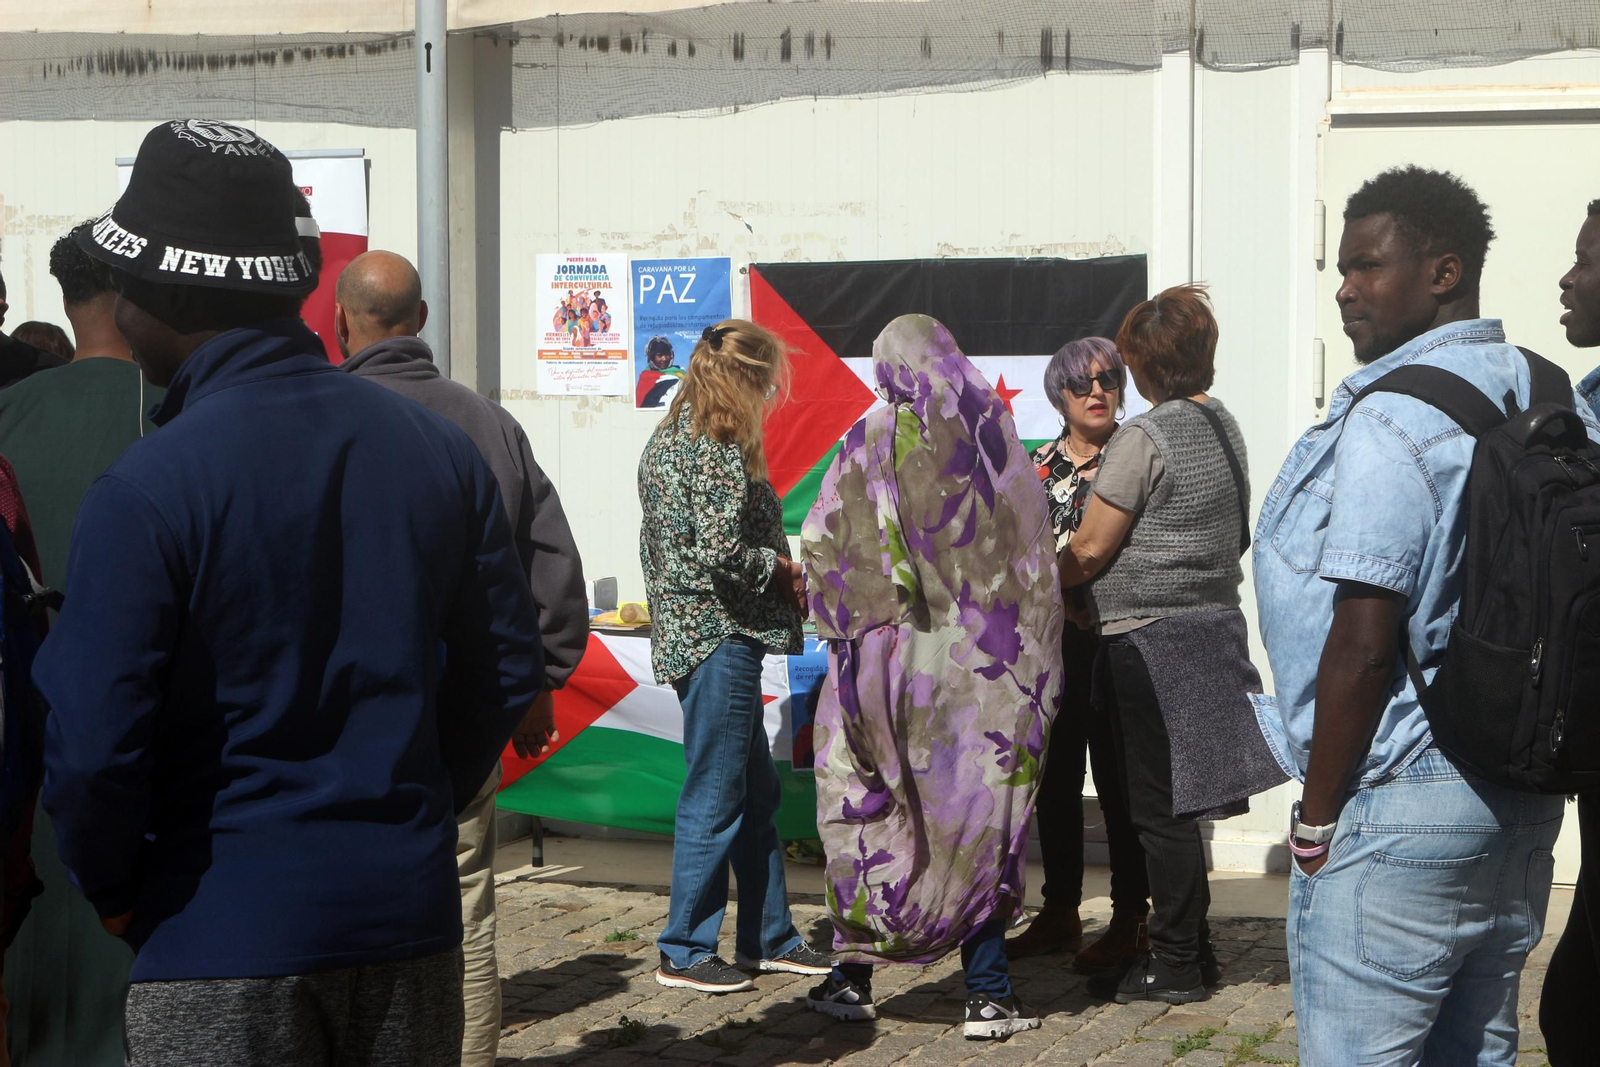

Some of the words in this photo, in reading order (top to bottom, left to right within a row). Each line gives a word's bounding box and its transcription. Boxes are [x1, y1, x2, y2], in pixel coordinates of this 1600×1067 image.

[158, 245, 231, 278] NEW
[235, 255, 300, 282] YORK
[557, 265, 607, 274] JORNADA
[551, 281, 613, 289] INTERCULTURAL
[640, 273, 696, 304] PAZ
